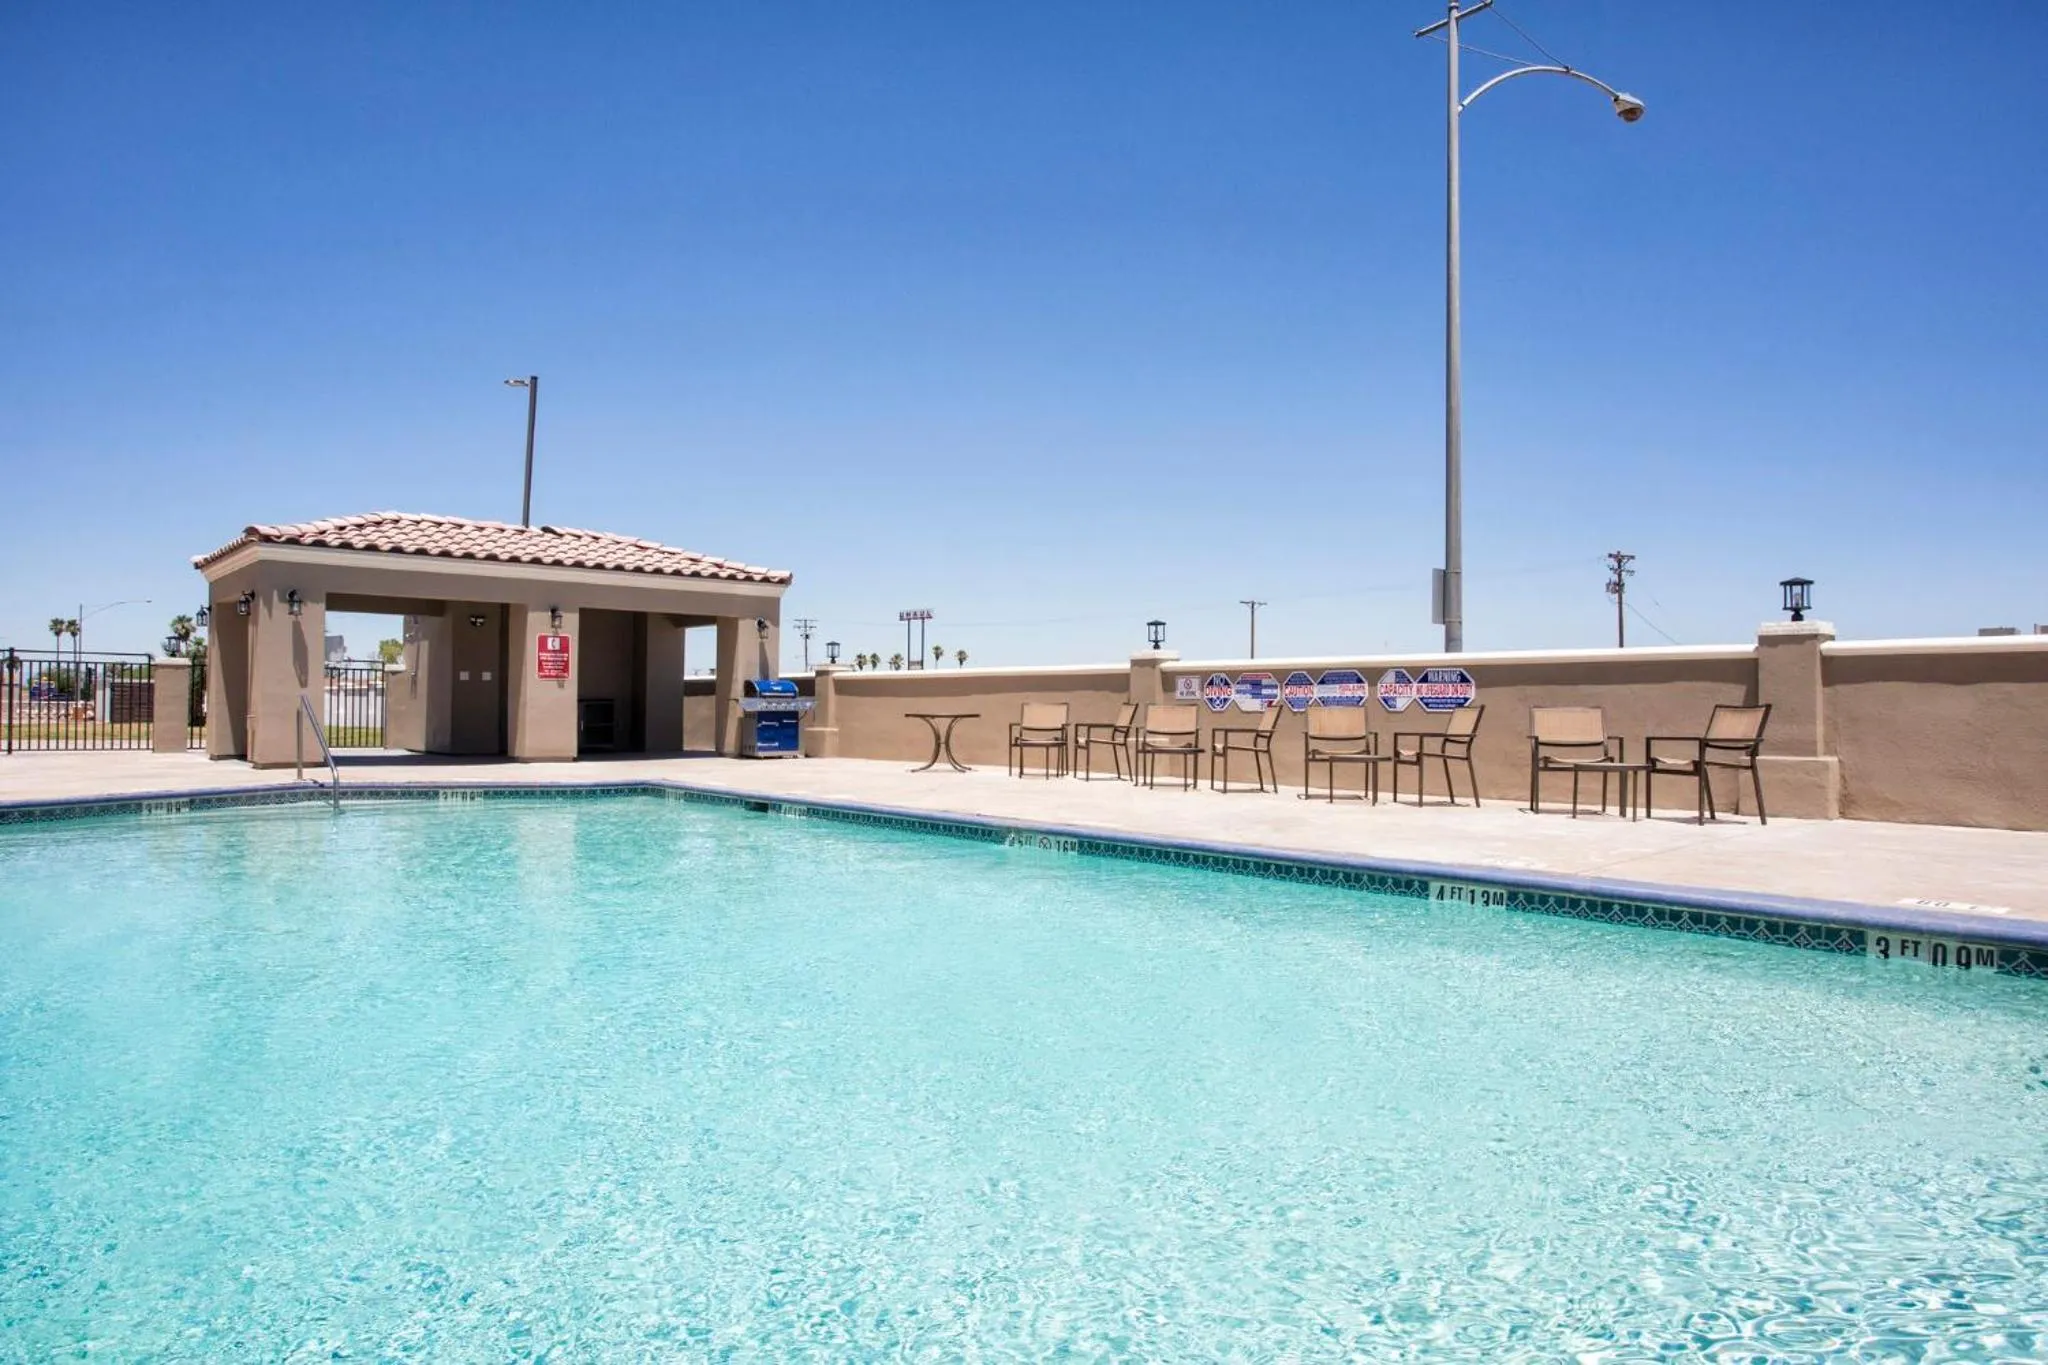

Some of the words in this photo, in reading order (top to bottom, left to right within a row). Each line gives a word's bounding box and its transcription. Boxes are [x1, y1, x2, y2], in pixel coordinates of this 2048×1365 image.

[1213, 675, 1226, 686] NO
[1428, 671, 1461, 683] WARNING
[1205, 687, 1232, 697] DIVING
[1285, 685, 1313, 697] CAUTION
[1380, 684, 1413, 696] CAPACITY
